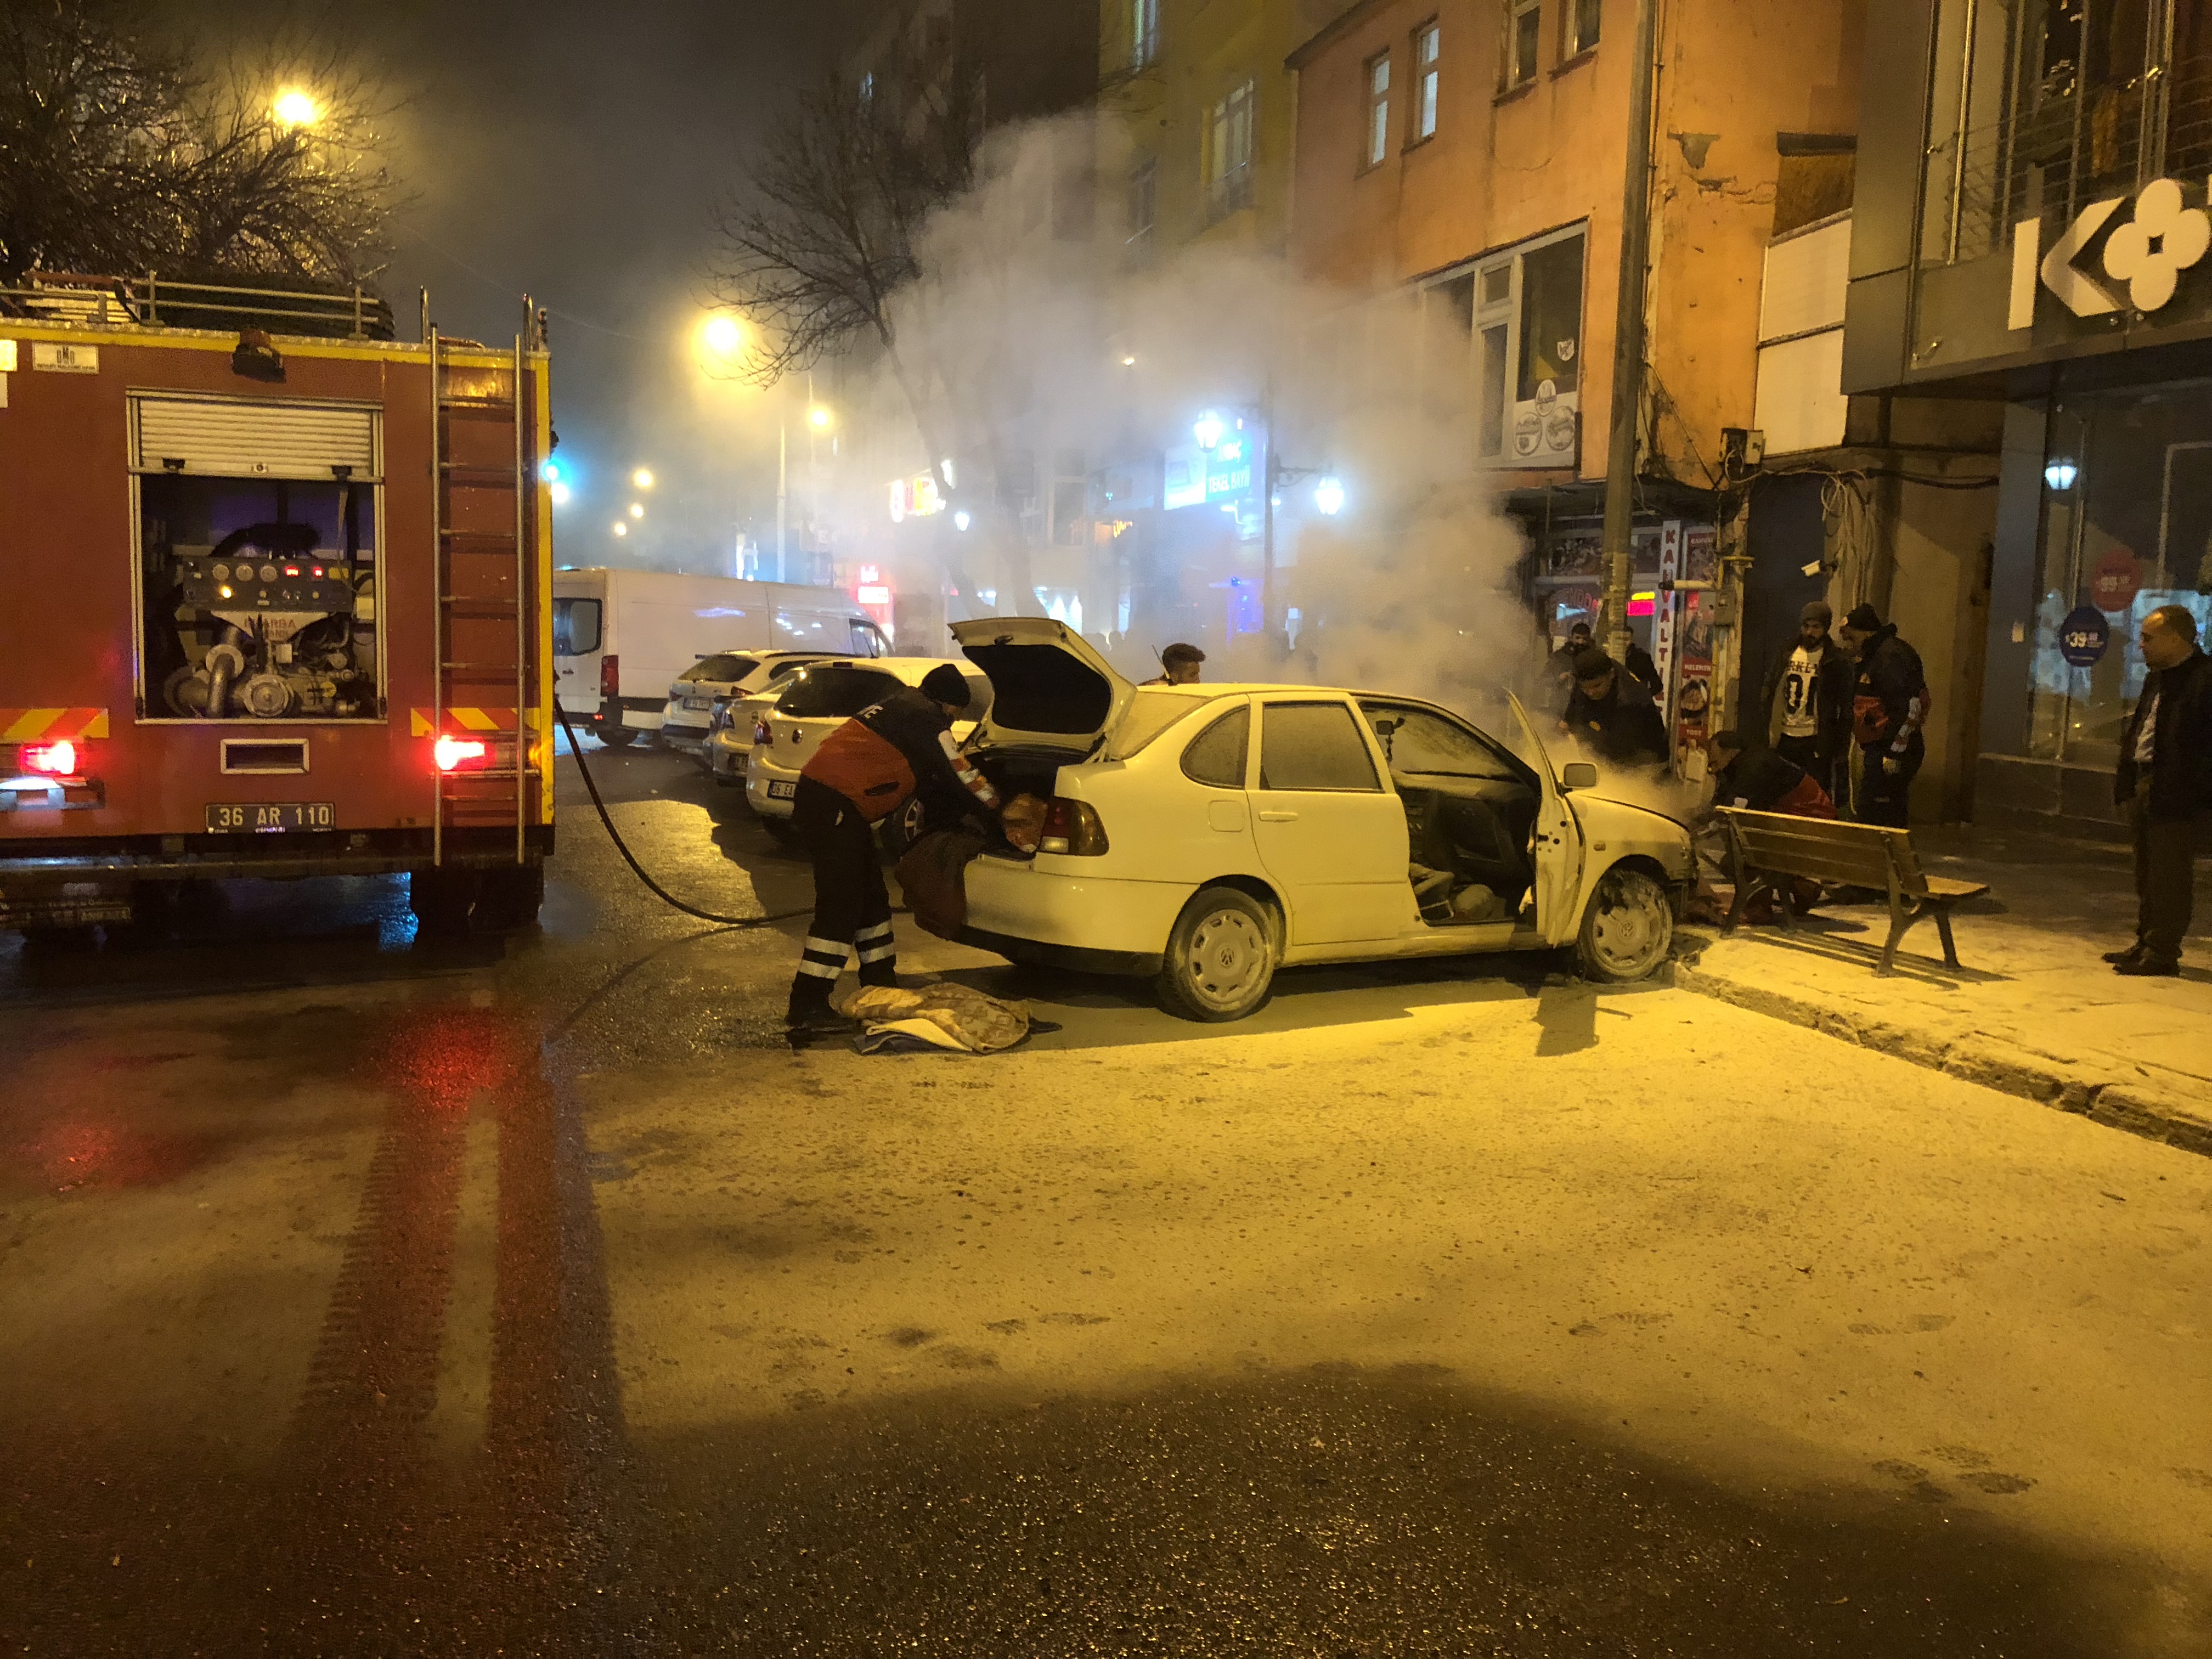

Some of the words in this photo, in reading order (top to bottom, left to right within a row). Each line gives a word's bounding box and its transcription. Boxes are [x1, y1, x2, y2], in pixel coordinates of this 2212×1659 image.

[2008, 174, 2212, 331] KO
[1207, 473, 1230, 493] TEKEL
[219, 808, 243, 826] 36
[257, 808, 280, 825] AR
[296, 806, 329, 825] 110
